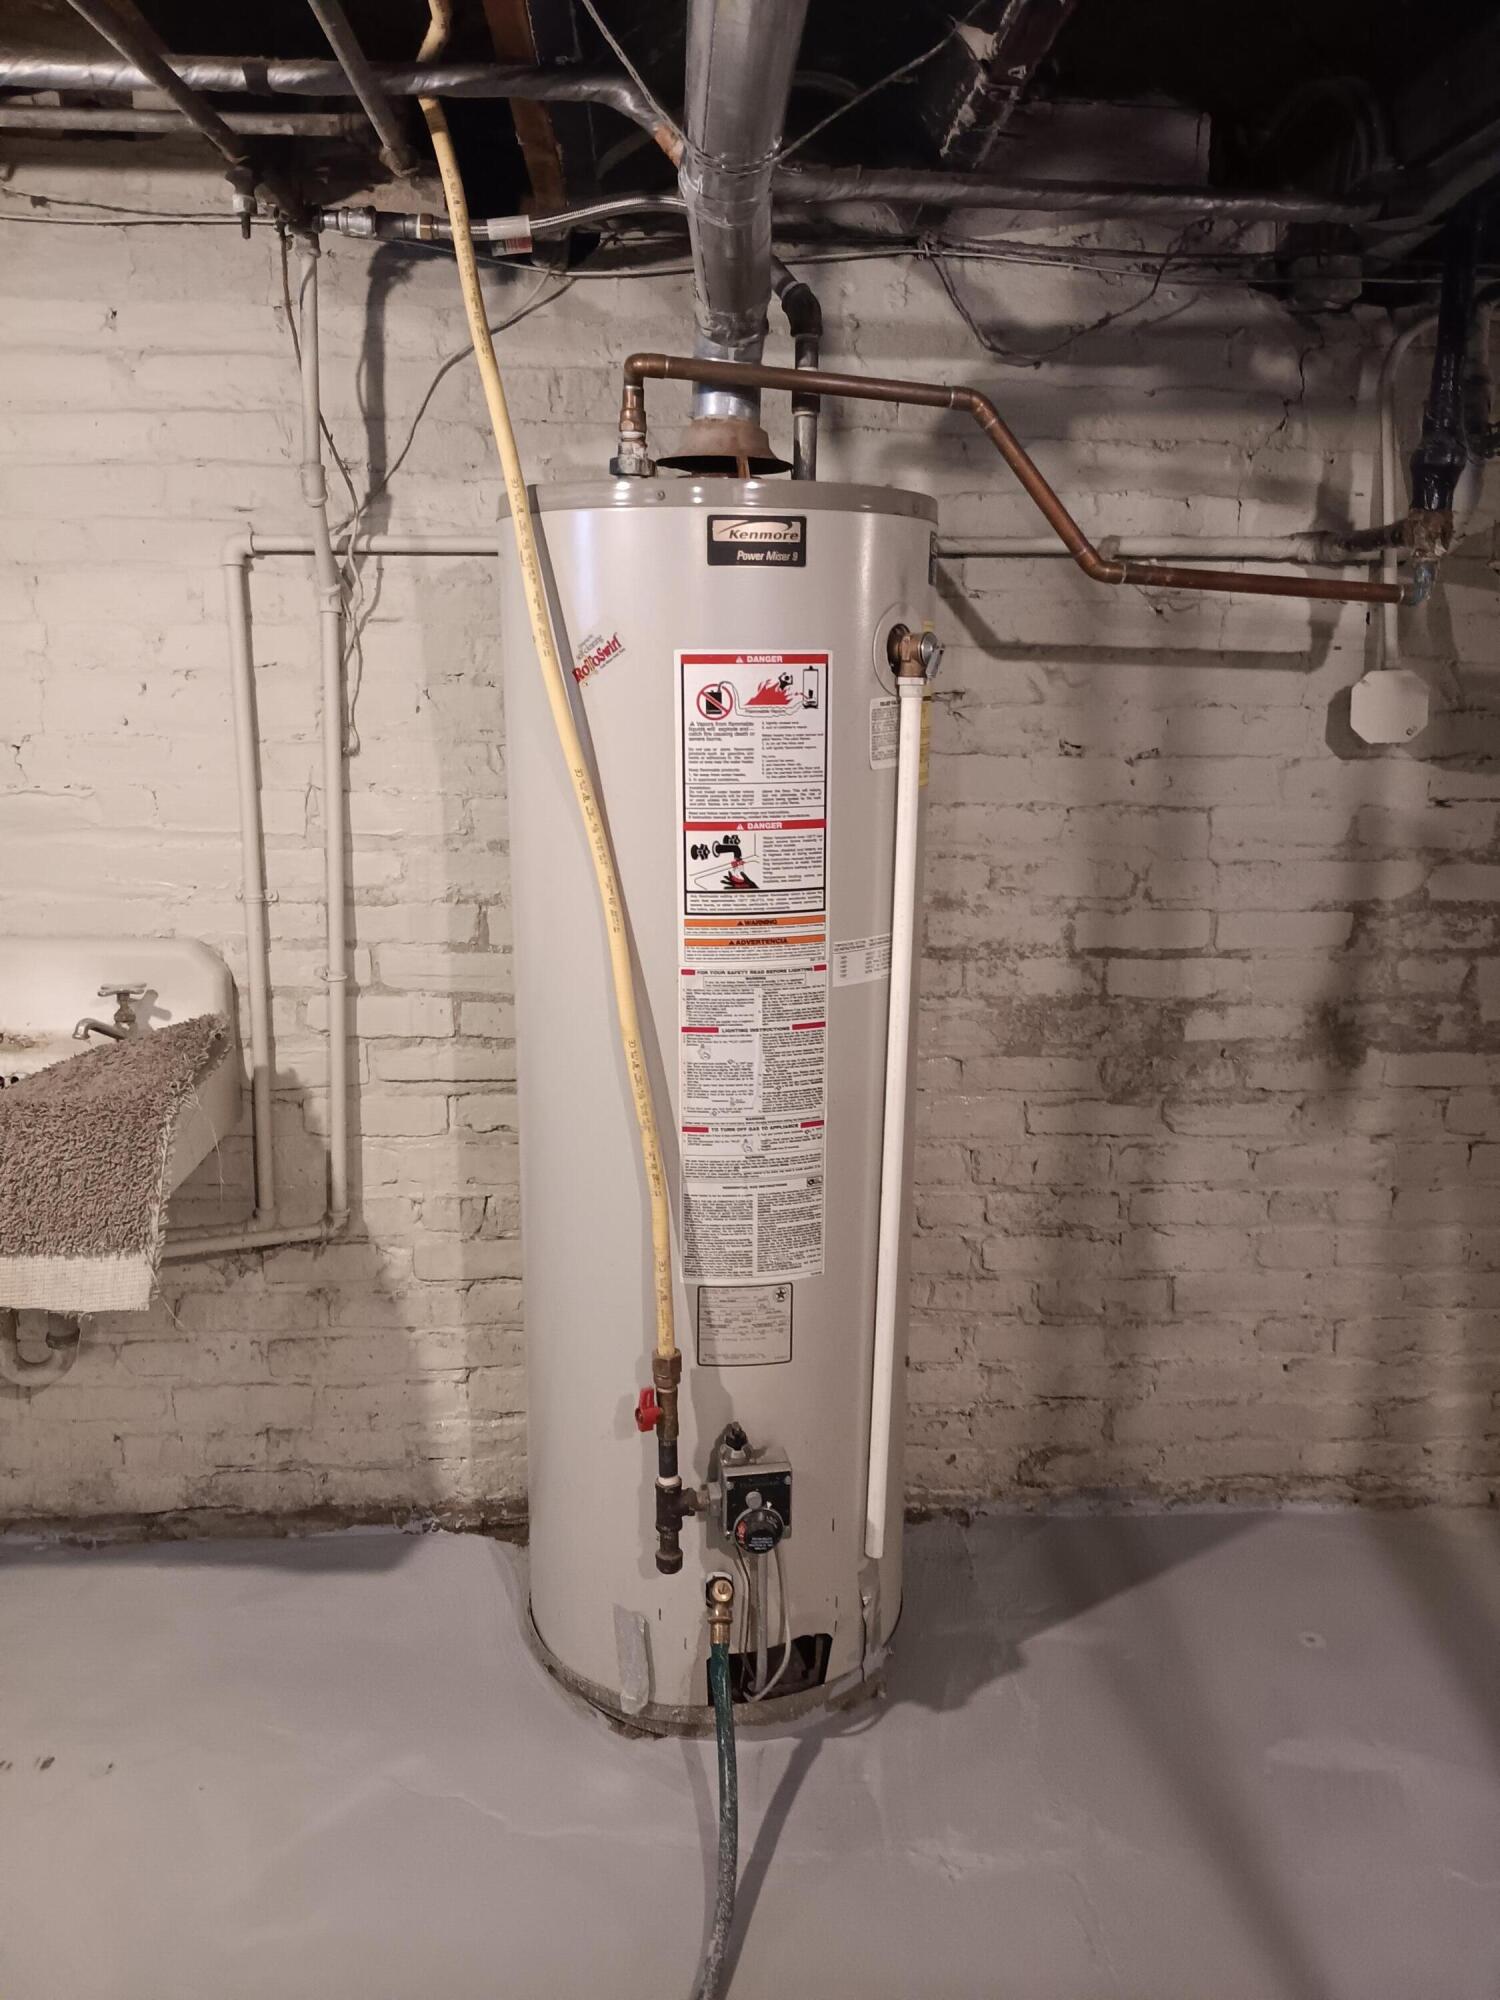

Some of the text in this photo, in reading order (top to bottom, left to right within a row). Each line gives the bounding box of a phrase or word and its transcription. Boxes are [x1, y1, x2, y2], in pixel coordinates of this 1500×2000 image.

[729, 529, 799, 541] Kenmore
[736, 550, 765, 561] Power
[766, 551, 791, 561] Miser
[746, 655, 783, 663] DANGER
[747, 822, 783, 830] DANGER
[736, 938, 788, 946] ADVERTENCIA
